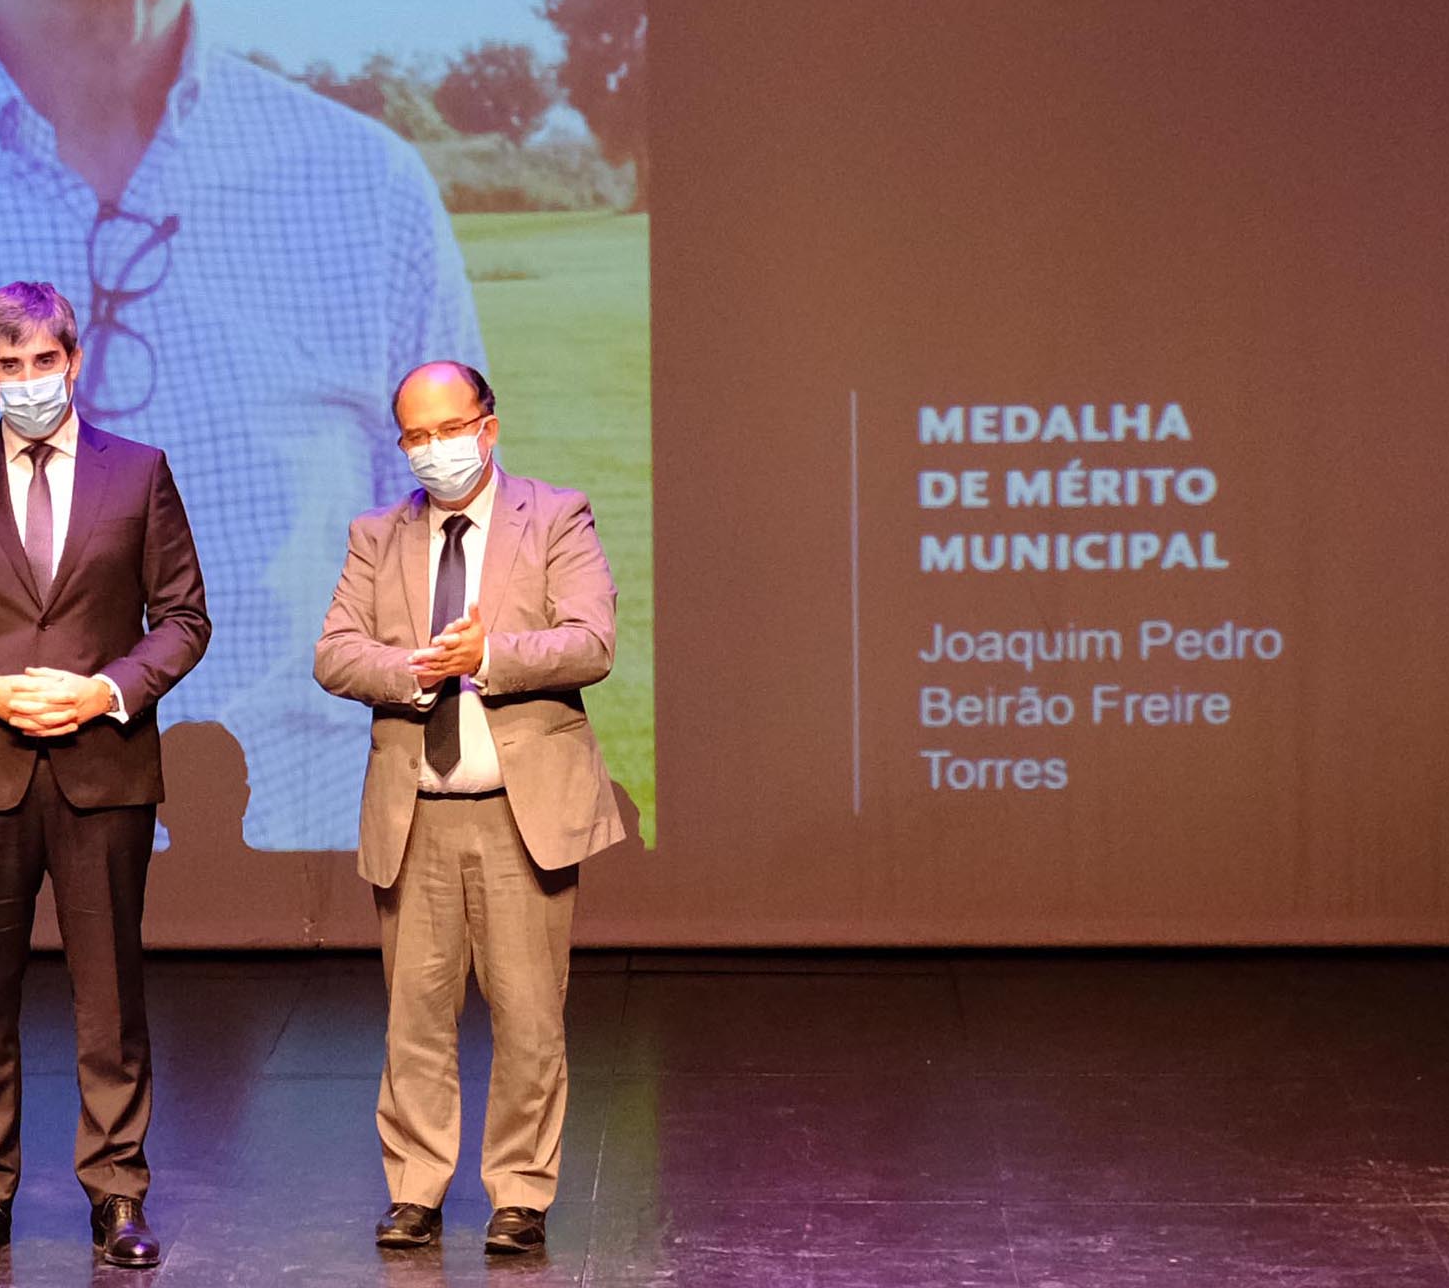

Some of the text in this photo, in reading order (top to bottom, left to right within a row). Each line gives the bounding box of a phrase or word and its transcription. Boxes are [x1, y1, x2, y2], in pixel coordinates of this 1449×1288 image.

[918, 402, 1191, 444] MEDALHA
[917, 458, 1217, 509] DE MÉRITO
[919, 531, 1229, 572] MUNICIPAL
[918, 619, 1284, 673] Joaquim Pedro
[919, 684, 1231, 728] Beirão Freire
[919, 749, 1069, 791] Torres
